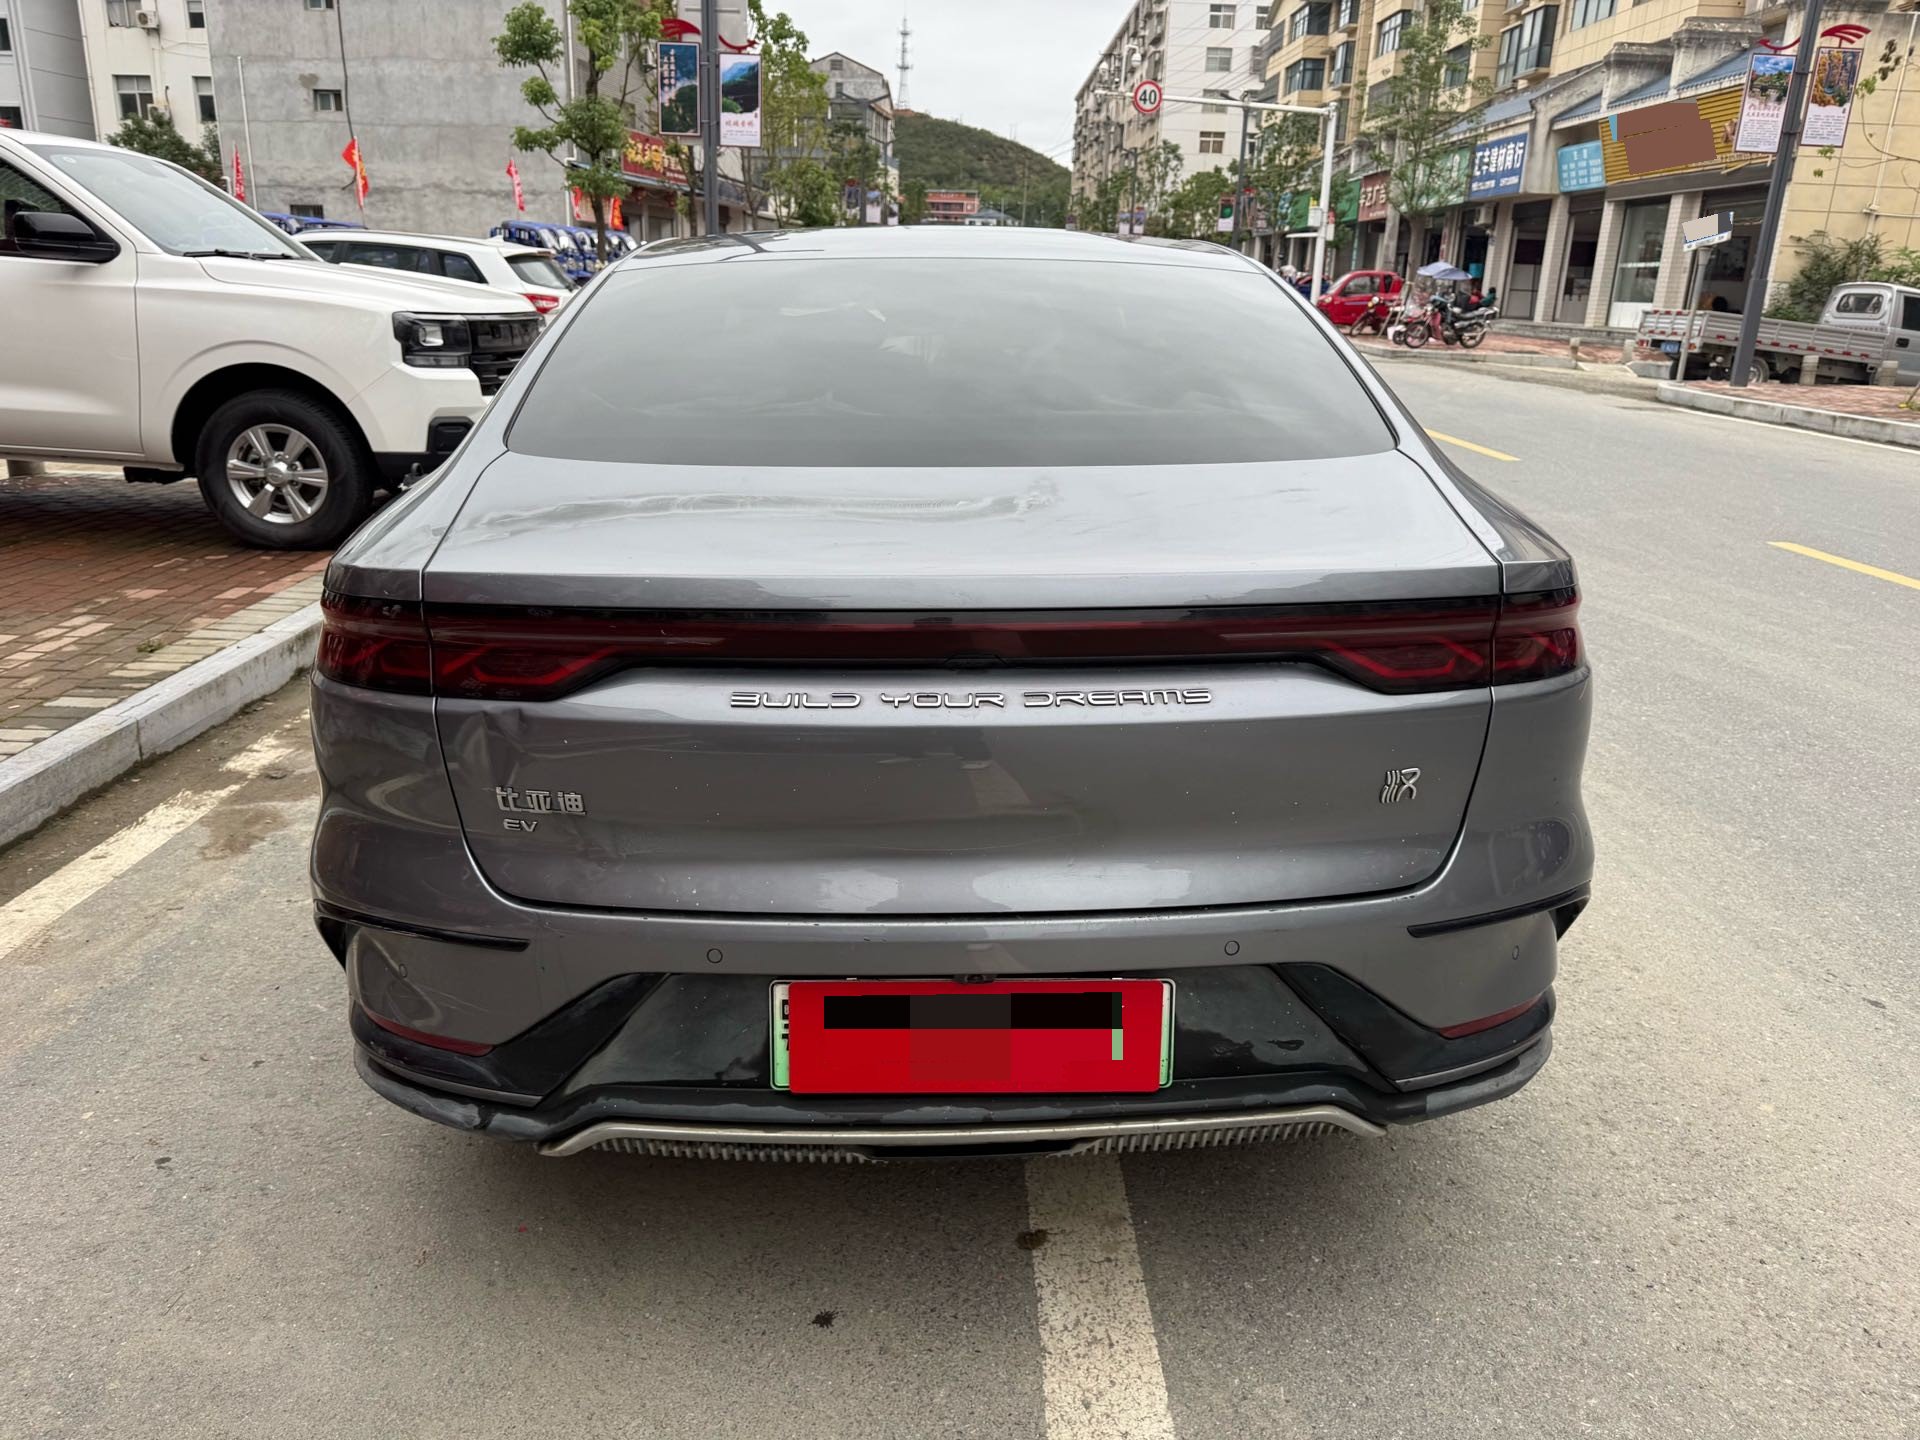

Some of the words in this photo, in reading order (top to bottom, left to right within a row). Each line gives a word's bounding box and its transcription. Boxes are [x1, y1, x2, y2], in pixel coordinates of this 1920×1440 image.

[1138, 89, 1157, 105] 40
[1473, 141, 1525, 177] 汇丰建材商行
[731, 691, 861, 708] BUILD
[880, 692, 1004, 708] YOUR
[1023, 688, 1212, 708] DREAMS
[495, 786, 587, 816] 比亚迪
[503, 818, 538, 832] EV
